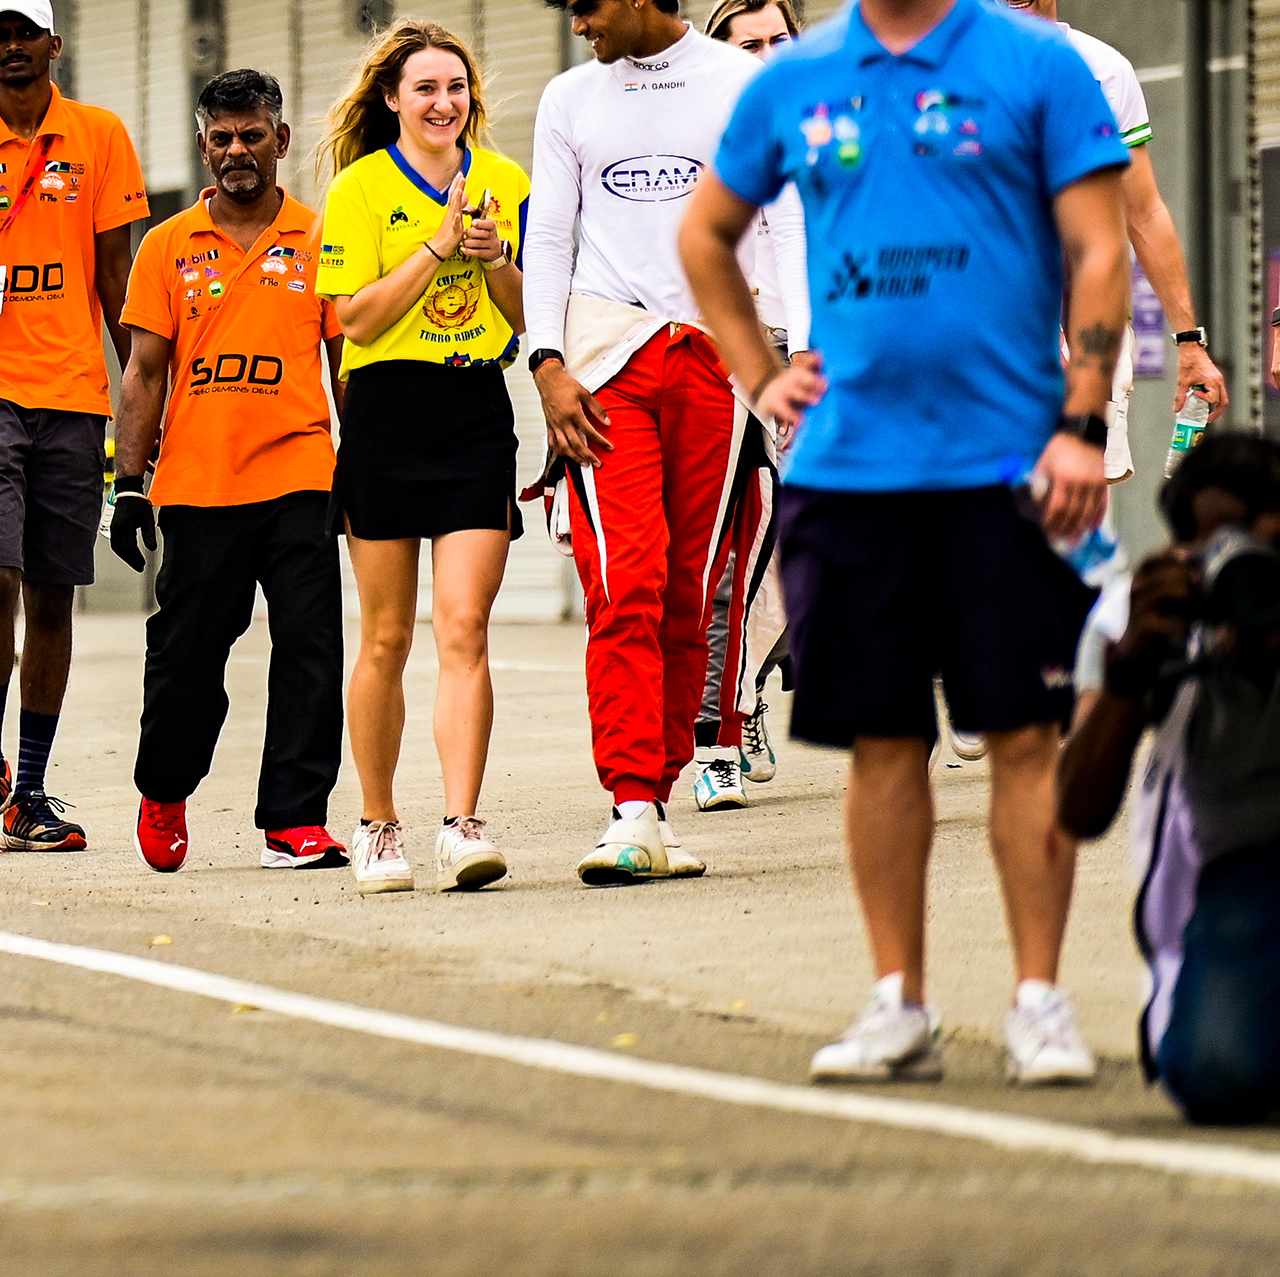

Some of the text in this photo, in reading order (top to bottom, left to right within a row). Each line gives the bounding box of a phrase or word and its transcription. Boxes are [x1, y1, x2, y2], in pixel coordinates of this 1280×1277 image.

[651, 81, 686, 90] GANDHI
[625, 185, 685, 193] MOTORSPORT
[3, 263, 64, 293] DD
[420, 323, 486, 343] TURBO RIDERS
[189, 353, 283, 388] SDD
[211, 386, 249, 394] DEMONS
